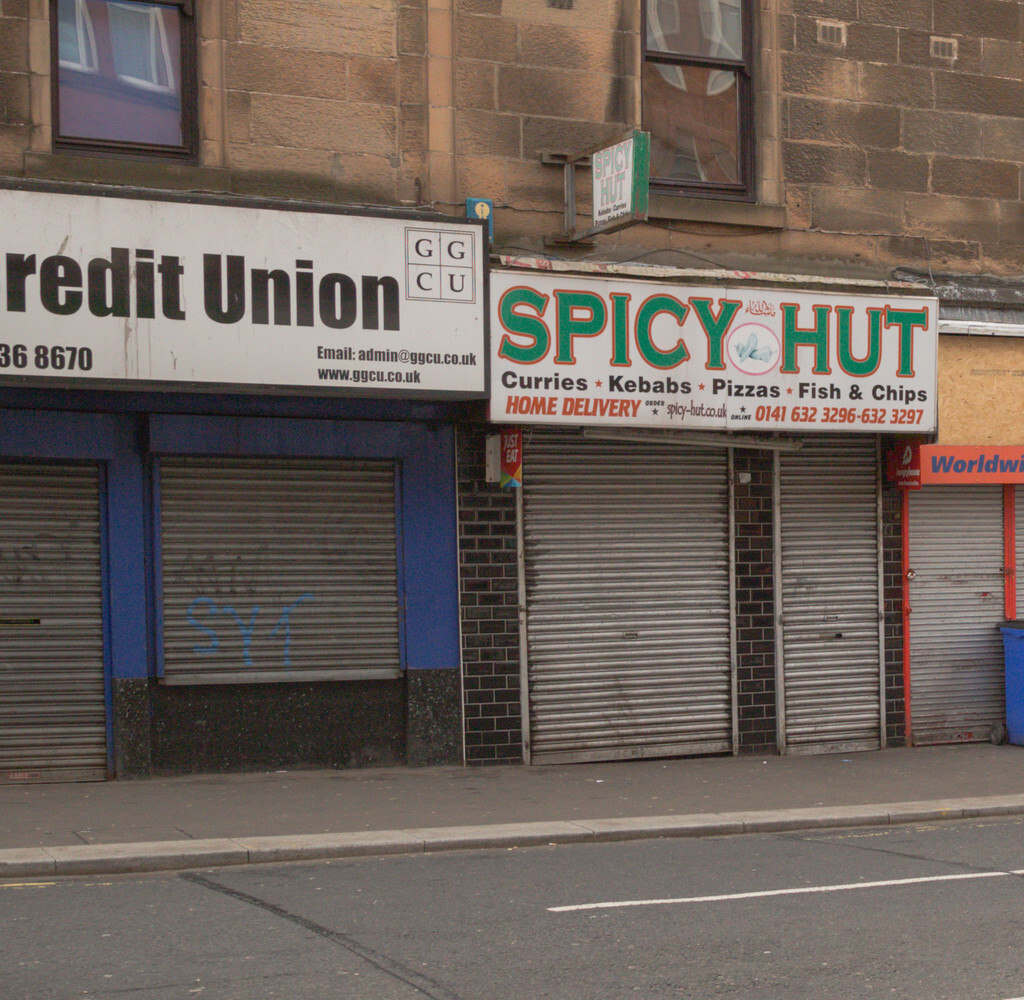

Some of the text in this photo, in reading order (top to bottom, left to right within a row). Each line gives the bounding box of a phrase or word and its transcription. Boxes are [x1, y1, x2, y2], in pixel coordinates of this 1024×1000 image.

[595, 141, 632, 180] SPICY
[600, 173, 625, 206] HUT
[6, 247, 400, 331] redit Union
[498, 285, 929, 378] SPICY HUT
[0, 344, 93, 370] 36 8670
[317, 346, 476, 366] Email: admin@ggcu.co.uk
[318, 368, 421, 383] www.ggcu.co.uk
[501, 371, 927, 404] Curries Kebabs Pizzas Fish & Chips
[505, 395, 642, 418] HOME DELIVERY
[667, 400, 727, 421] spicy-hut.co.uk
[755, 405, 924, 424] 0141 632 3296-632 3297
[504, 434, 518, 450] JUST
[506, 449, 519, 463] EAT
